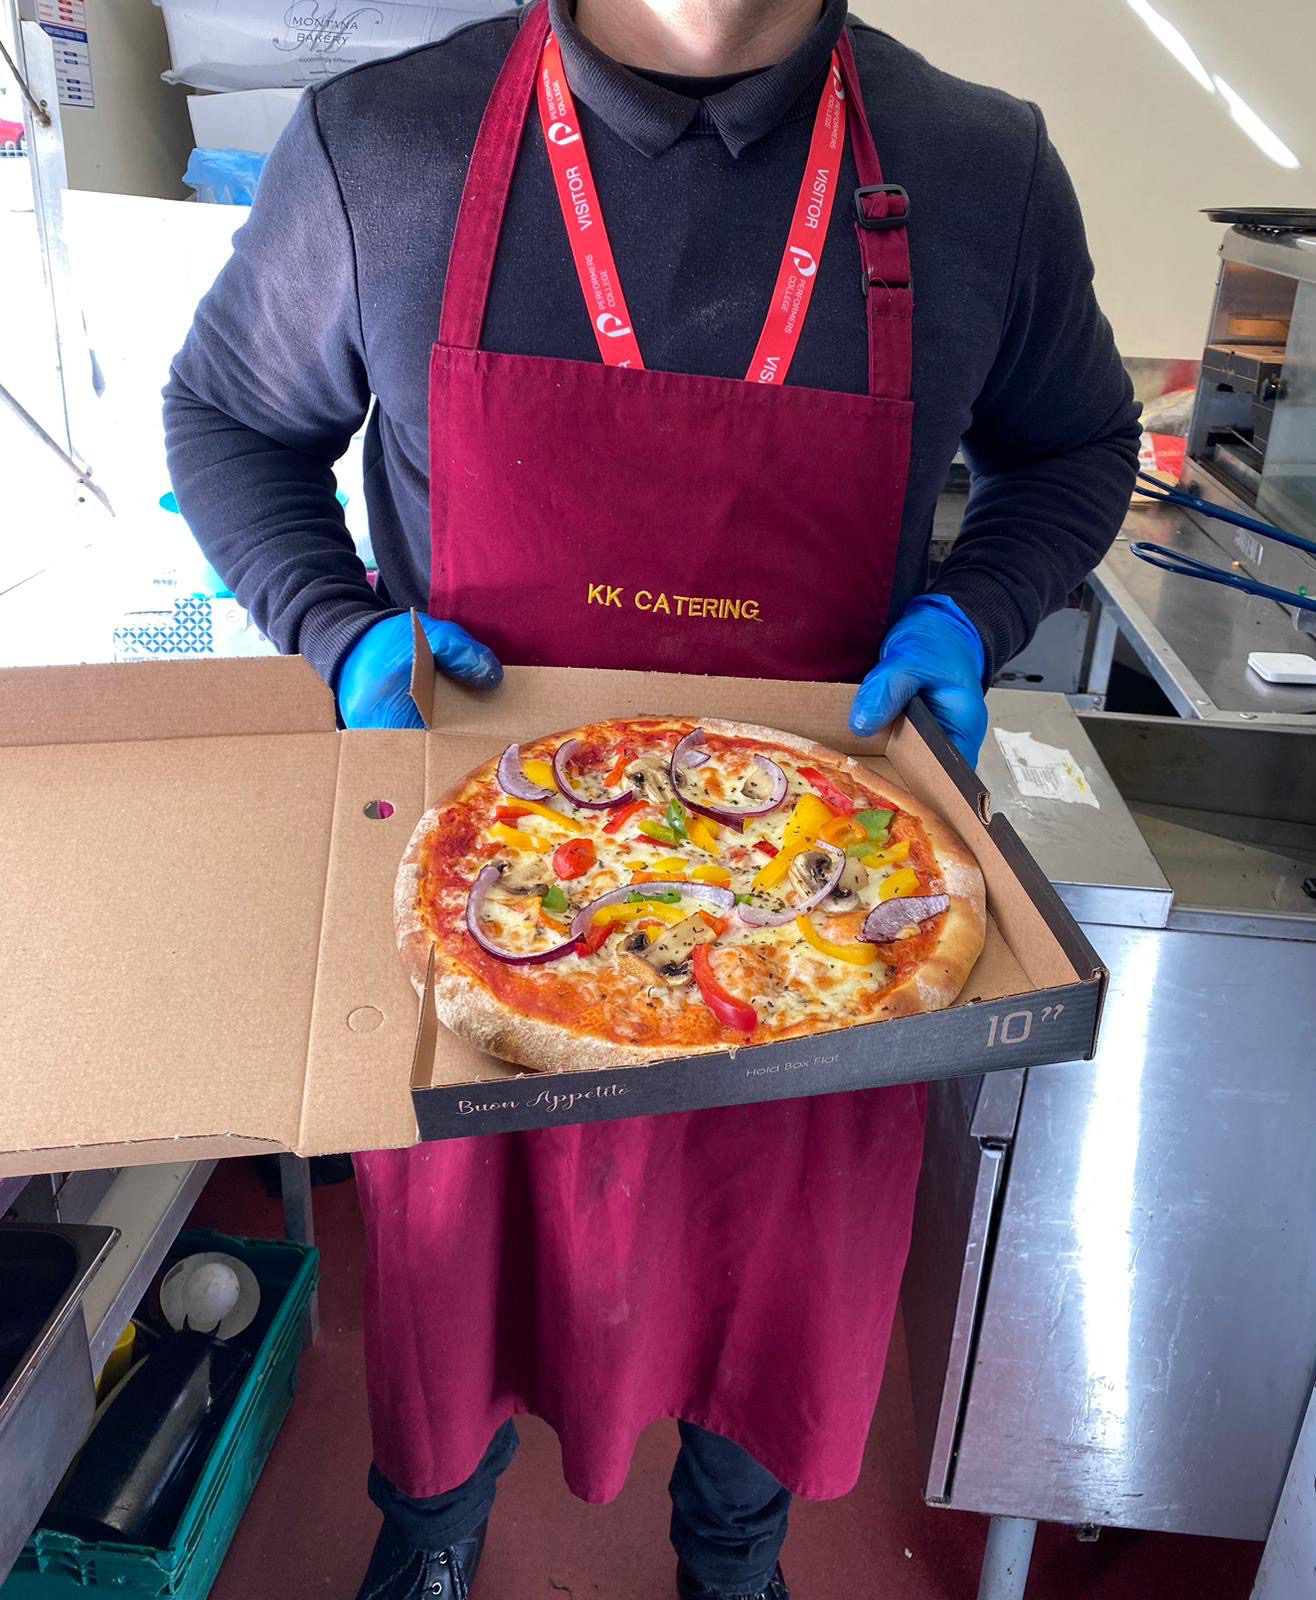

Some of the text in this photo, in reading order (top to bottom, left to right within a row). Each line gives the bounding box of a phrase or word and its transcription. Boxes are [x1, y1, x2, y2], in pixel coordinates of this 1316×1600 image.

[292, 16, 358, 29] MONTANA
[296, 32, 350, 45] BAKERY
[543, 68, 558, 120] PERFORMERS
[552, 79, 567, 116] COLLEGE
[824, 94, 835, 129] COLLEGE
[830, 99, 841, 150] PERFORMERS
[566, 165, 592, 231] VISITOR
[805, 169, 830, 229] VISITOR
[585, 254, 605, 310] PERFORMERS
[600, 269, 616, 307] COLLEGE
[781, 275, 797, 313] COLLEGE
[784, 278, 806, 334] PERFORMERS
[587, 583, 761, 621] KK CATERING
[746, 1054, 840, 1077] Hold Box Flat
[456, 1100, 520, 1115] Buon
